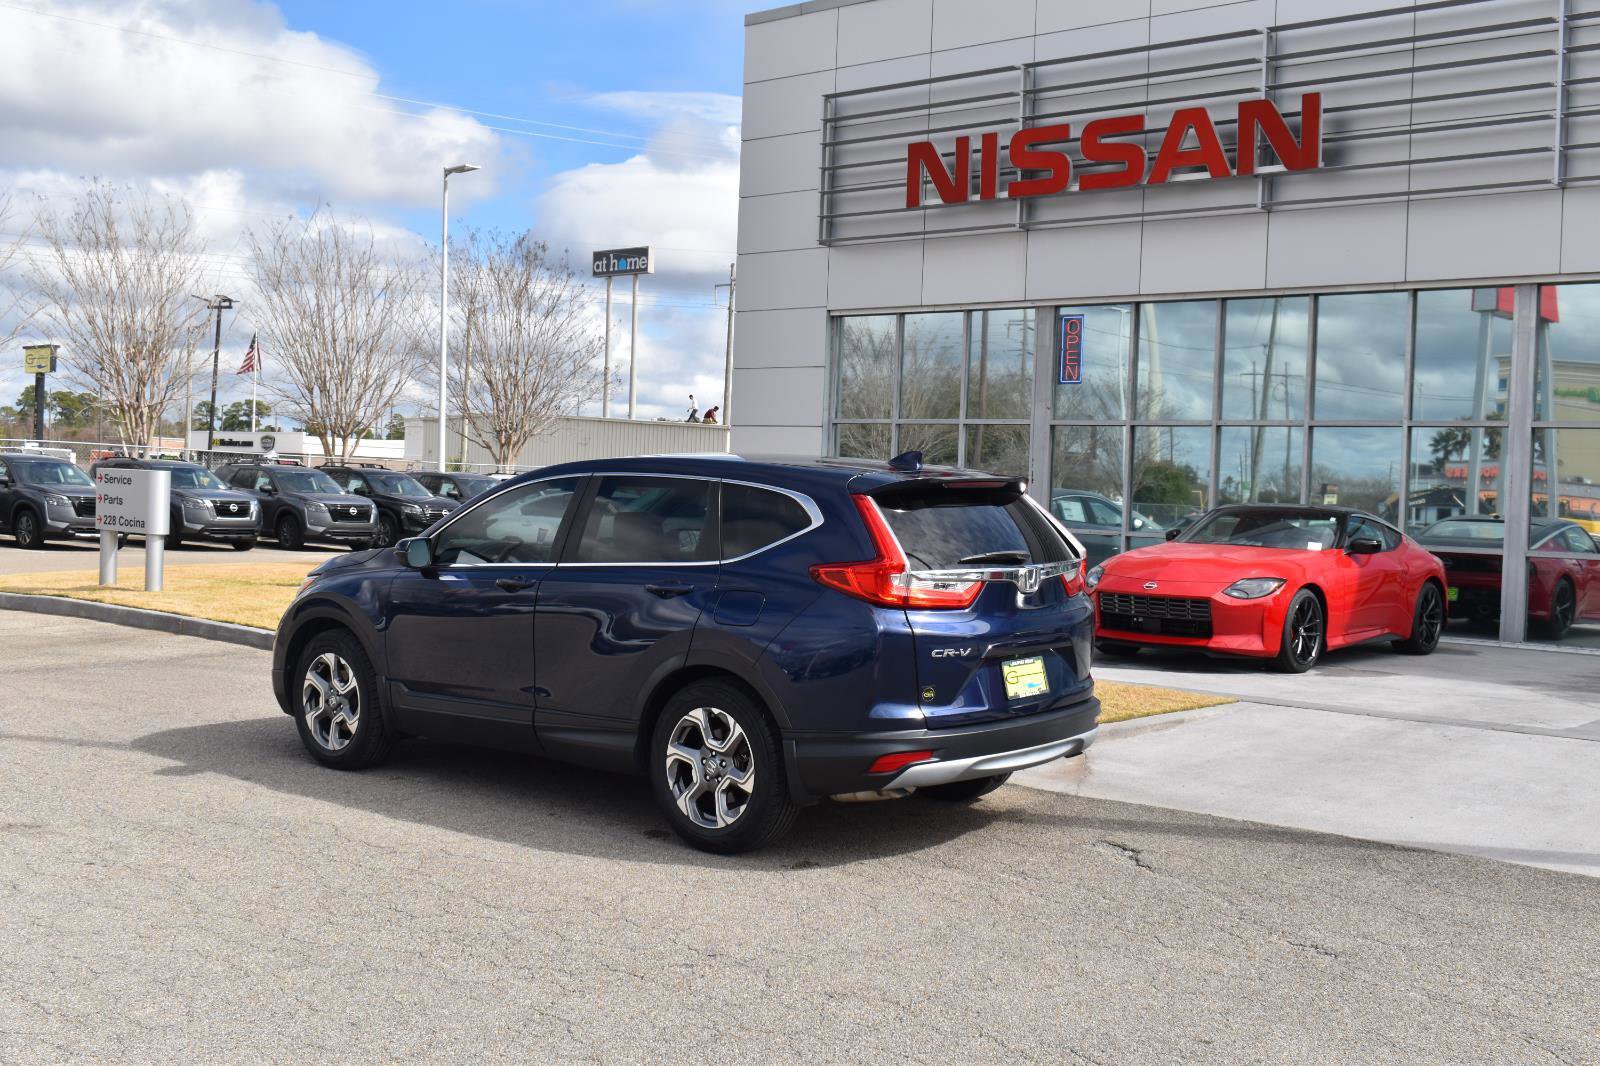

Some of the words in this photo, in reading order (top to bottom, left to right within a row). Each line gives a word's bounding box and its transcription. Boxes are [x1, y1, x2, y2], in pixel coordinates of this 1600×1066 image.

[906, 92, 1321, 209] NISSAN
[594, 257, 606, 272] at
[609, 253, 648, 271] home
[1066, 319, 1081, 380] OPEN
[104, 473, 132, 485] Service
[103, 494, 124, 505] Parts
[103, 514, 117, 526] 228
[118, 515, 146, 528] Cocina
[931, 647, 972, 658] CR-V
